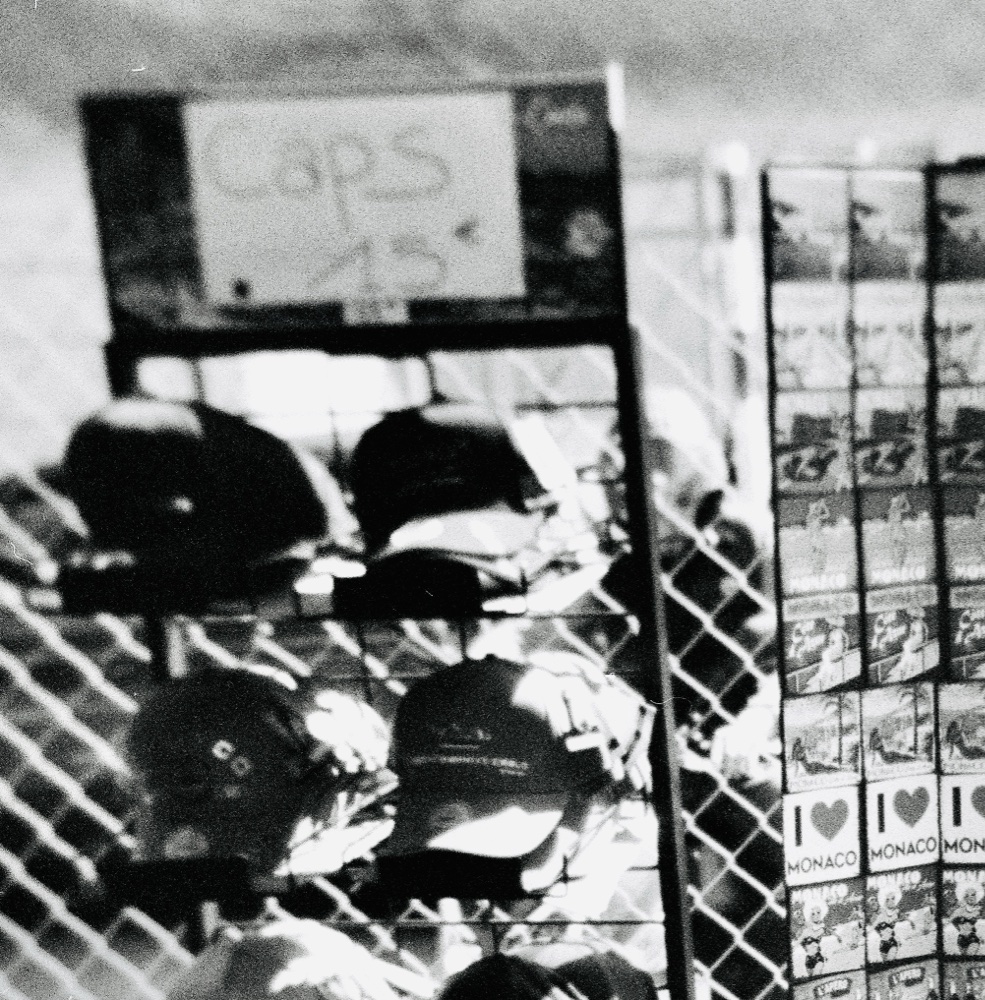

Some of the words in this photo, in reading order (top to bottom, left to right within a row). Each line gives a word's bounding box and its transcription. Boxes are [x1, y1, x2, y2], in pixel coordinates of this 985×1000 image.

[794, 805, 802, 847] I
[877, 793, 886, 833] I
[952, 785, 961, 827] I
[787, 850, 857, 875] MONACO
[869, 836, 938, 861] MONACO
